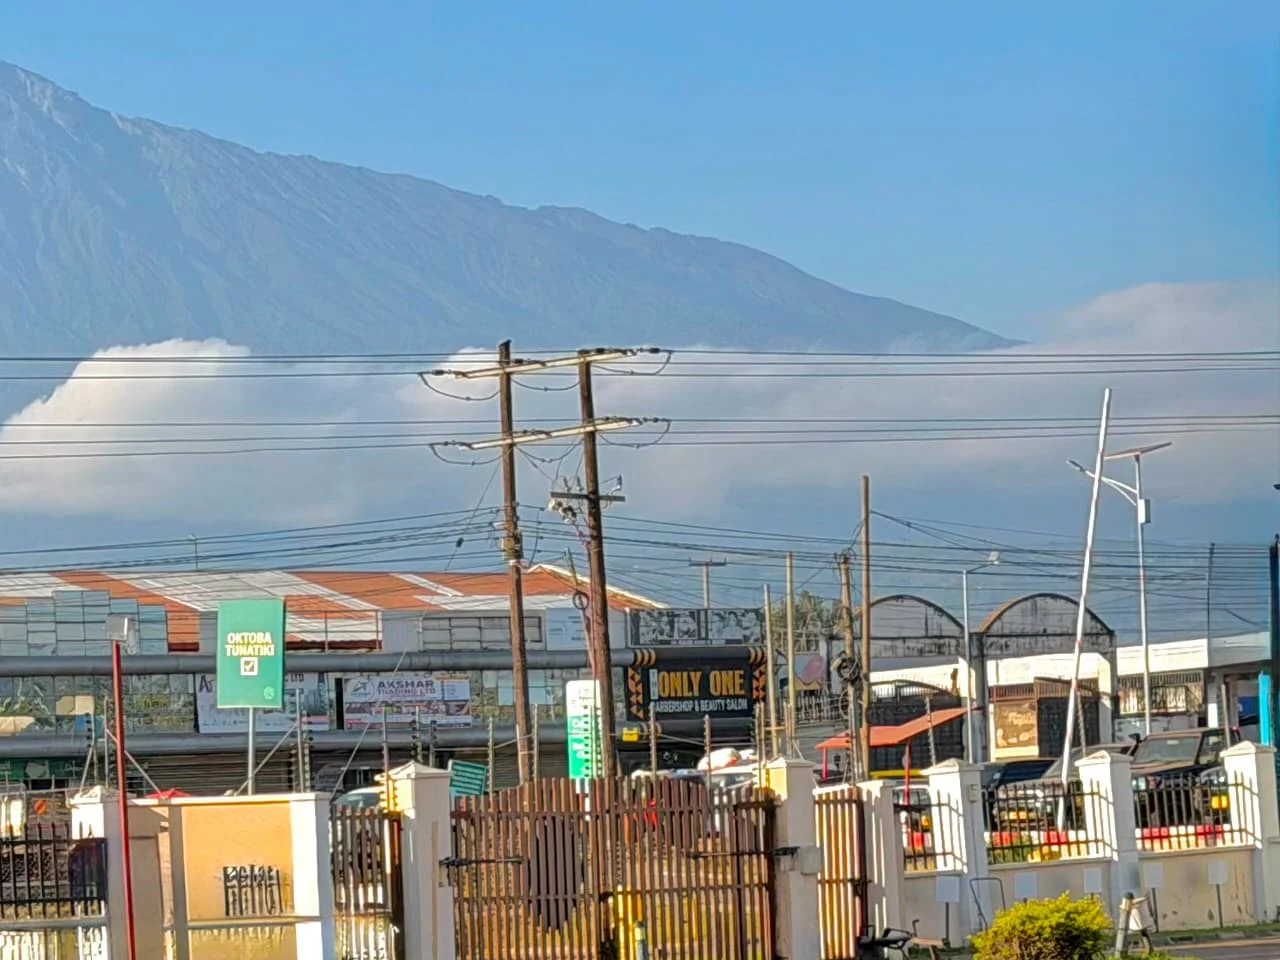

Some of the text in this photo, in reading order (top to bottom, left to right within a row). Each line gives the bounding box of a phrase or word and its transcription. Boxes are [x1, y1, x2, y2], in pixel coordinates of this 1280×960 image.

[227, 632, 272, 644] OKTOBA
[225, 644, 275, 657] TUNATIKI
[377, 680, 434, 689] AKSHAR
[658, 670, 745, 698] ONLY ONE
[651, 700, 694, 713] ARBERSHOP
[700, 699, 725, 712] BEAUTY
[726, 698, 748, 711] SALON
